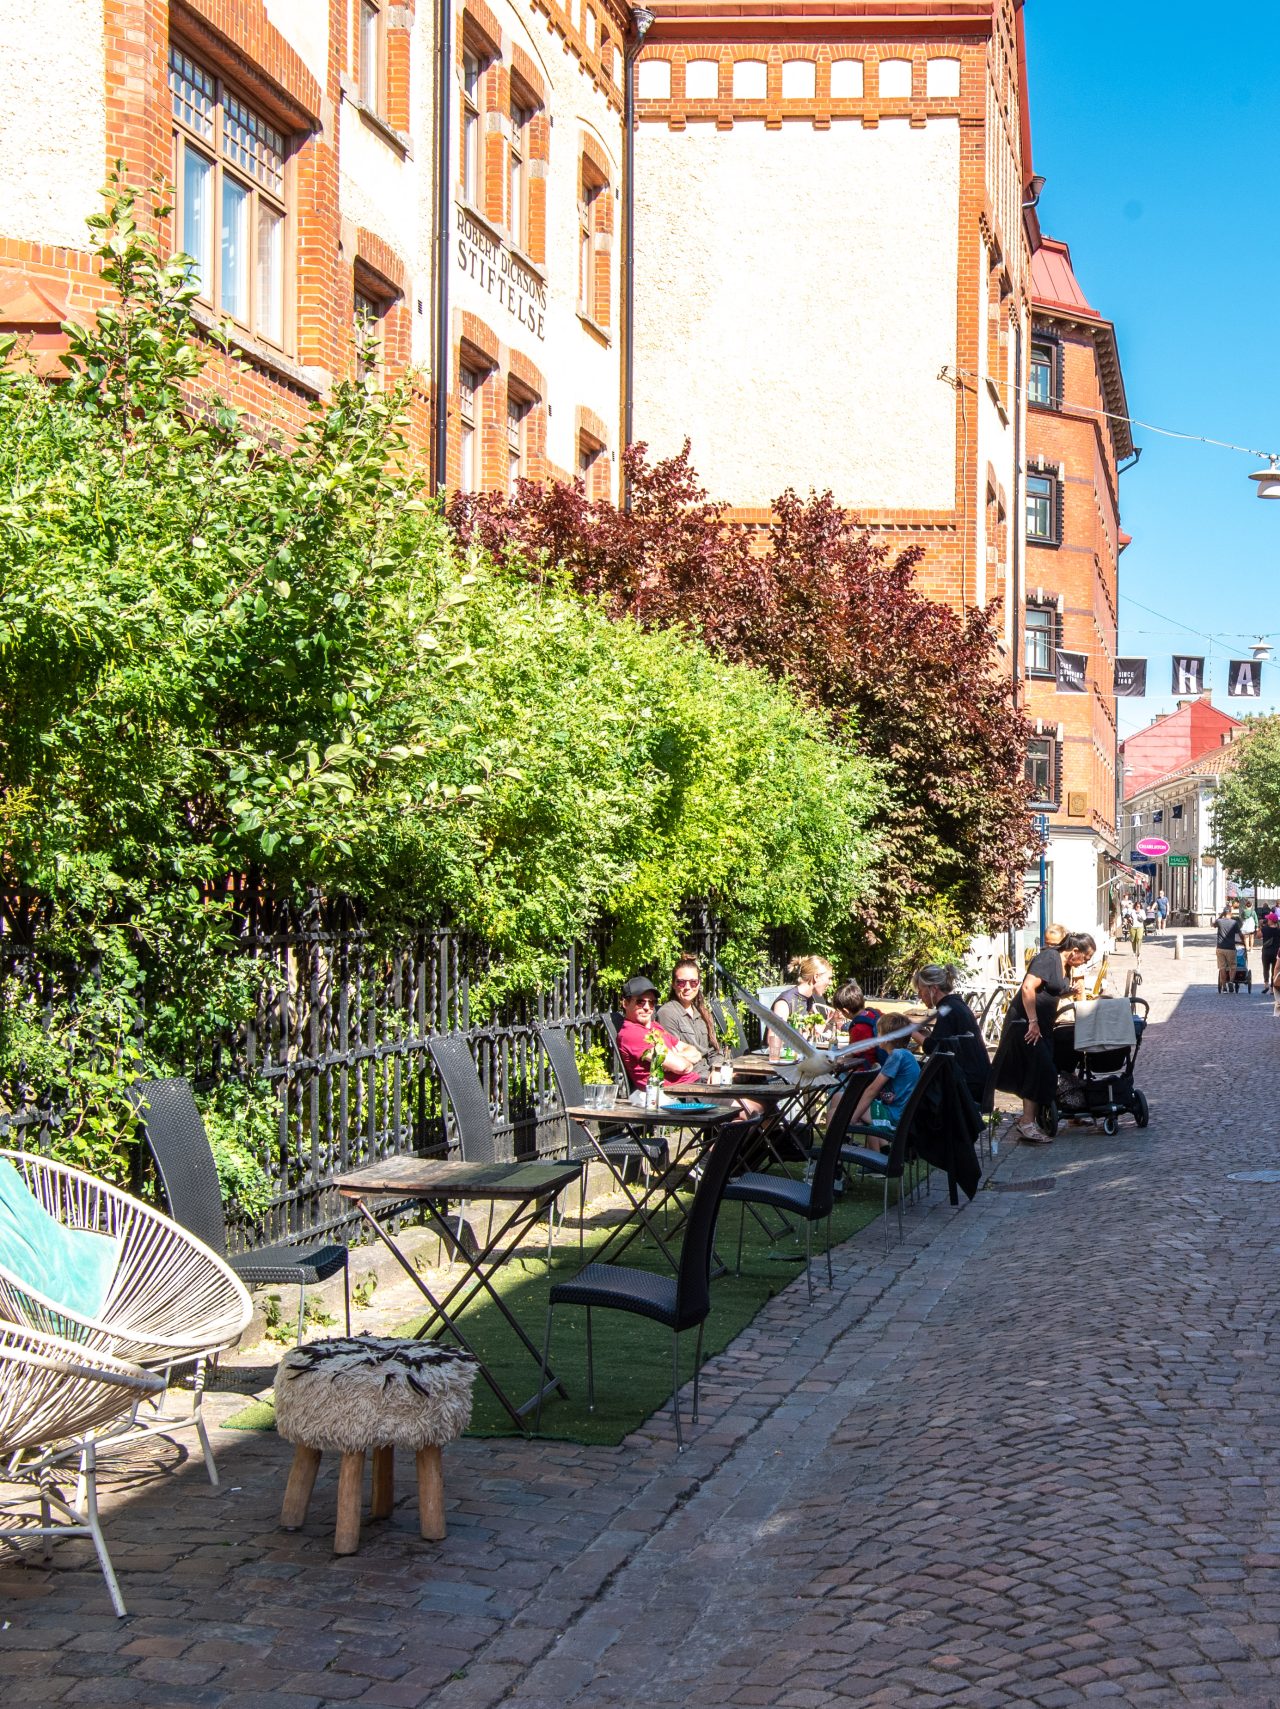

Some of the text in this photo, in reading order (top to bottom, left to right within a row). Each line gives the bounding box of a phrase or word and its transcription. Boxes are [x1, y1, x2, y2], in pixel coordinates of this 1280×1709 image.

[457, 209, 547, 311] ROBERT DICKSONS
[457, 239, 545, 342] STIFTELSE
